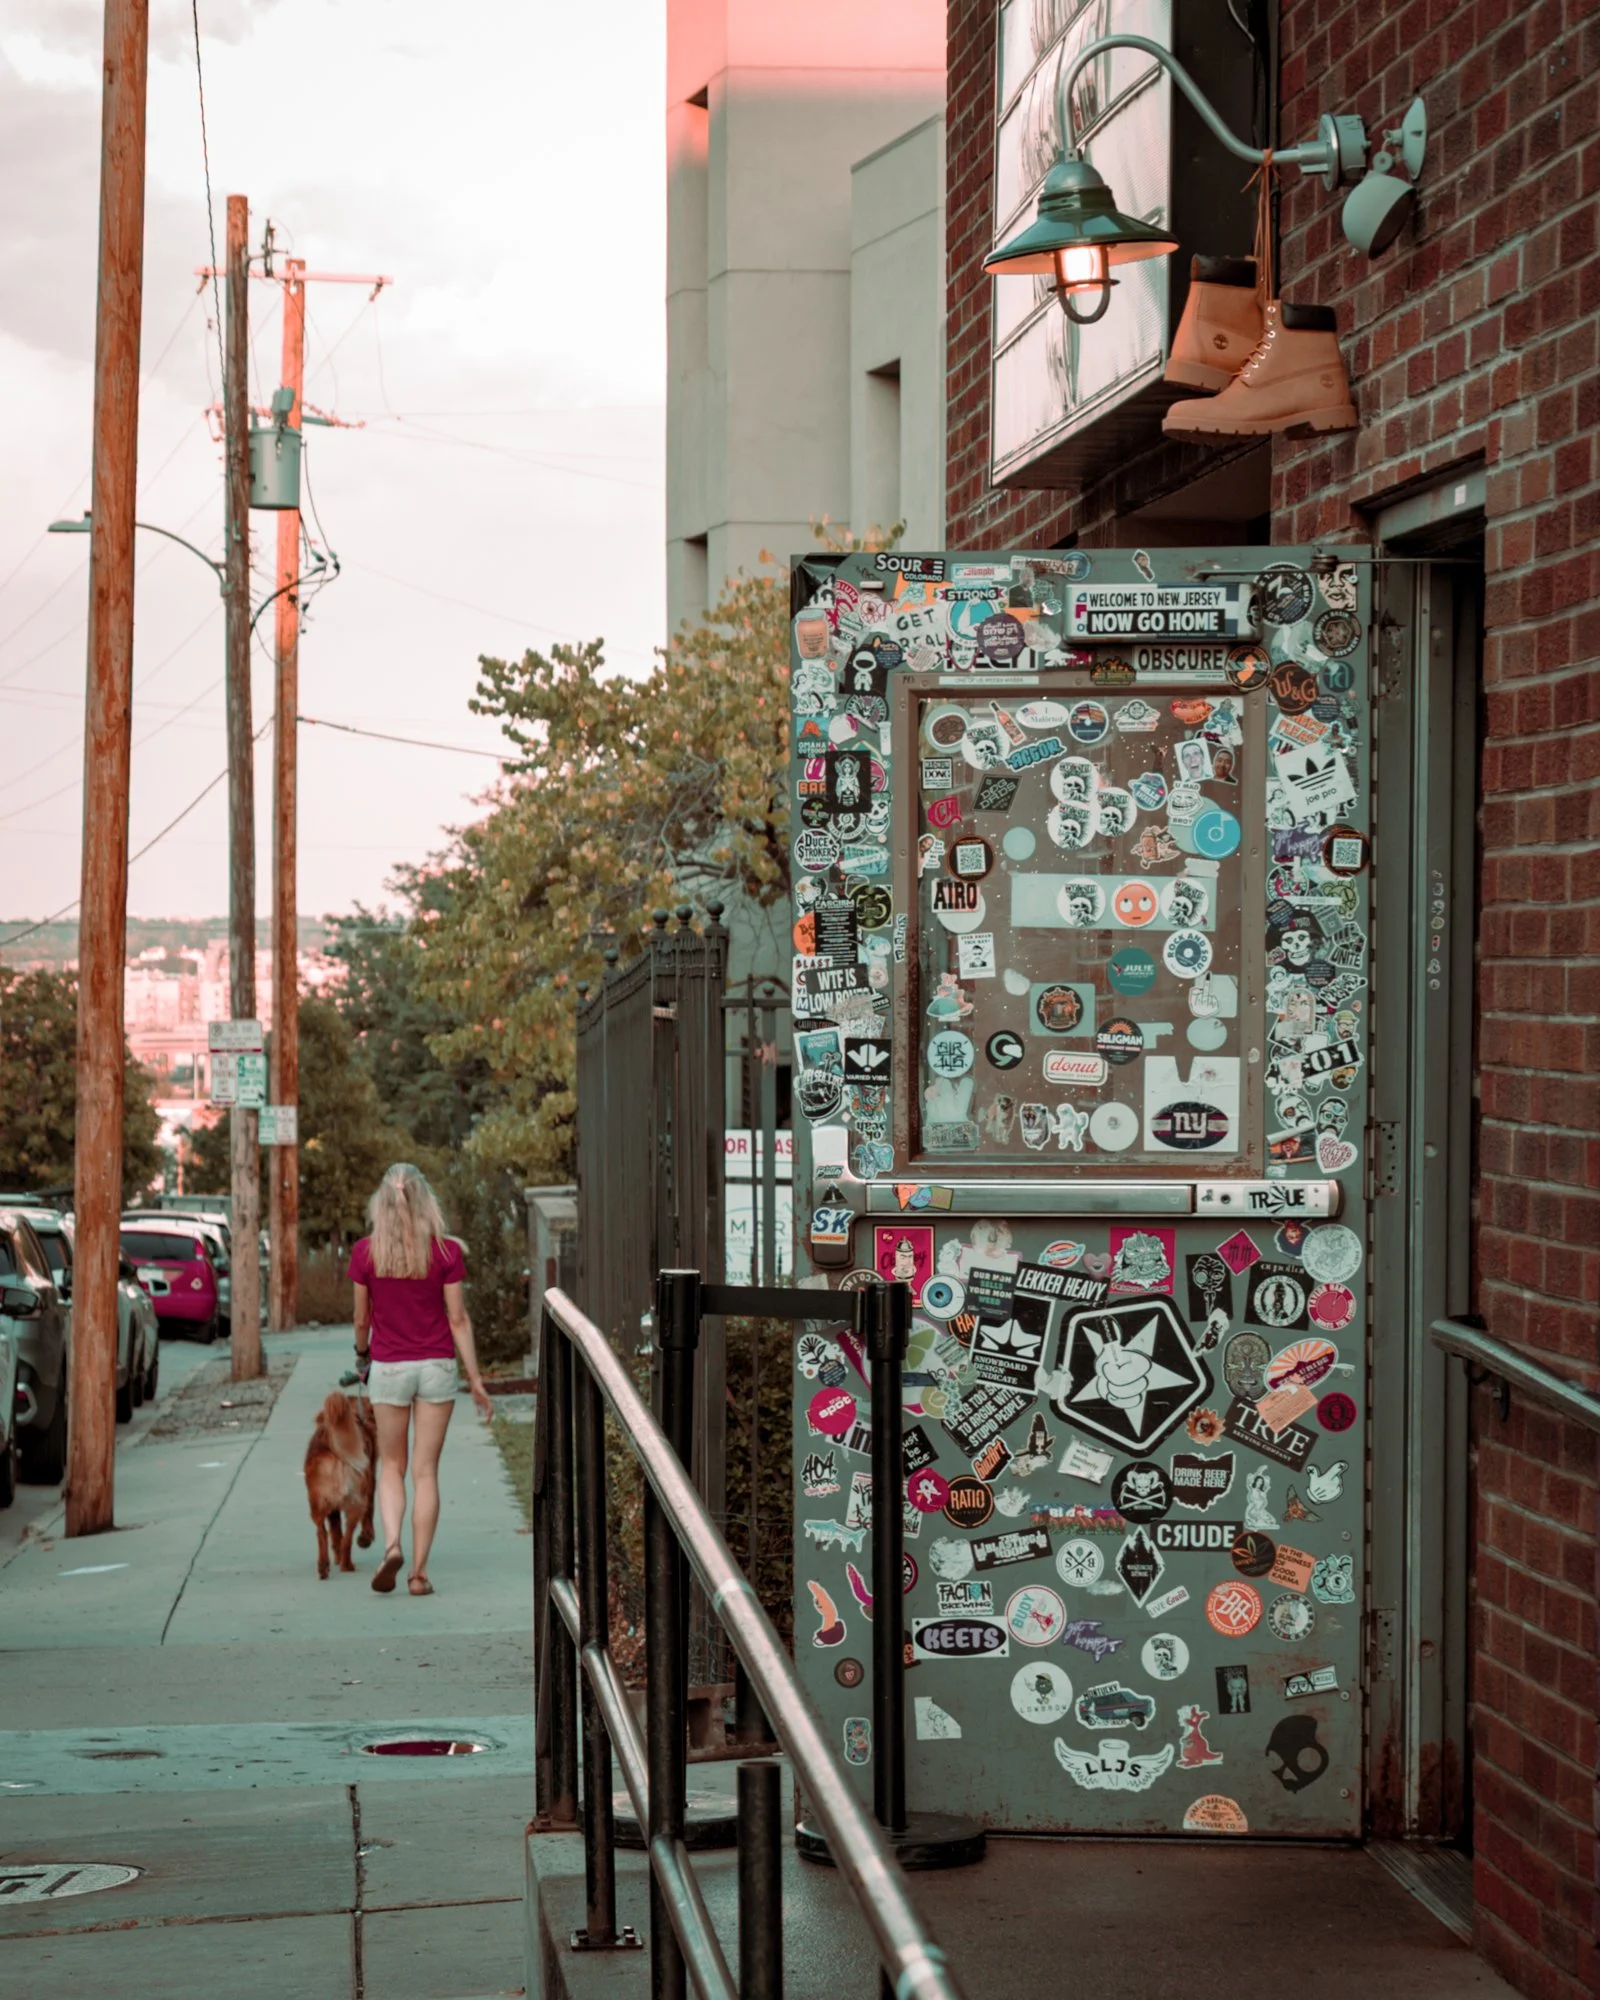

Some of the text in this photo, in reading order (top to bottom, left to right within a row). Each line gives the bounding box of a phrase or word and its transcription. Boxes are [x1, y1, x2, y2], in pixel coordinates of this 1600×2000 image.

[876, 554, 944, 574] SOURCE
[904, 573, 943, 581] COLORADO
[948, 589, 997, 600] STRONG
[1090, 591, 1221, 607] WELCOME TO NEW JERSEY
[897, 608, 935, 631] GET
[1091, 611, 1218, 632] NOW GO HOME
[1138, 649, 1223, 670] OBSCURE
[1322, 788, 1338, 800] pro
[805, 834, 828, 847] DUCE
[798, 845, 838, 858] STROKERS
[933, 882, 978, 911] AIRO
[1167, 932, 1209, 973] ROCK AND SOUL
[1331, 949, 1362, 968] UNITE
[795, 958, 831, 969] BLAST
[817, 968, 857, 990] WTF IS
[1097, 1033, 1142, 1045] SELIGMAN
[1050, 1057, 1098, 1073] donut
[726, 1138, 748, 1154] OR
[973, 1271, 1012, 1283] OUR MOM
[1016, 1268, 1107, 1301] LEKKER HEAVY
[969, 1286, 1012, 1299] YOUR MOM
[974, 1355, 1028, 1372] SNOWBOARD
[974, 1363, 1006, 1374] DESIGN
[976, 1370, 1018, 1385] YNDICATE
[969, 1388, 988, 1408] TOO
[819, 1396, 852, 1419] spot
[958, 1421, 973, 1437] TO
[971, 1403, 999, 1427] ARGUE
[968, 1395, 1027, 1448] STUPID PEOPLE
[909, 1445, 922, 1458] be
[802, 1450, 835, 1485] 404
[908, 1452, 931, 1470] nice
[1174, 1467, 1227, 1480] DRINK BEER
[1174, 1477, 1226, 1488] MADE HERE
[951, 1489, 985, 1510] RATIO
[1278, 1553, 1312, 1570] BUSINESS
[1289, 1548, 1304, 1559] THE
[1272, 1572, 1300, 1586] KARMA
[1274, 1566, 1297, 1578] GOOD
[941, 1602, 991, 1610] BREWING
[923, 1628, 1000, 1649] KEETS
[1085, 1759, 1142, 1777] LLJS
